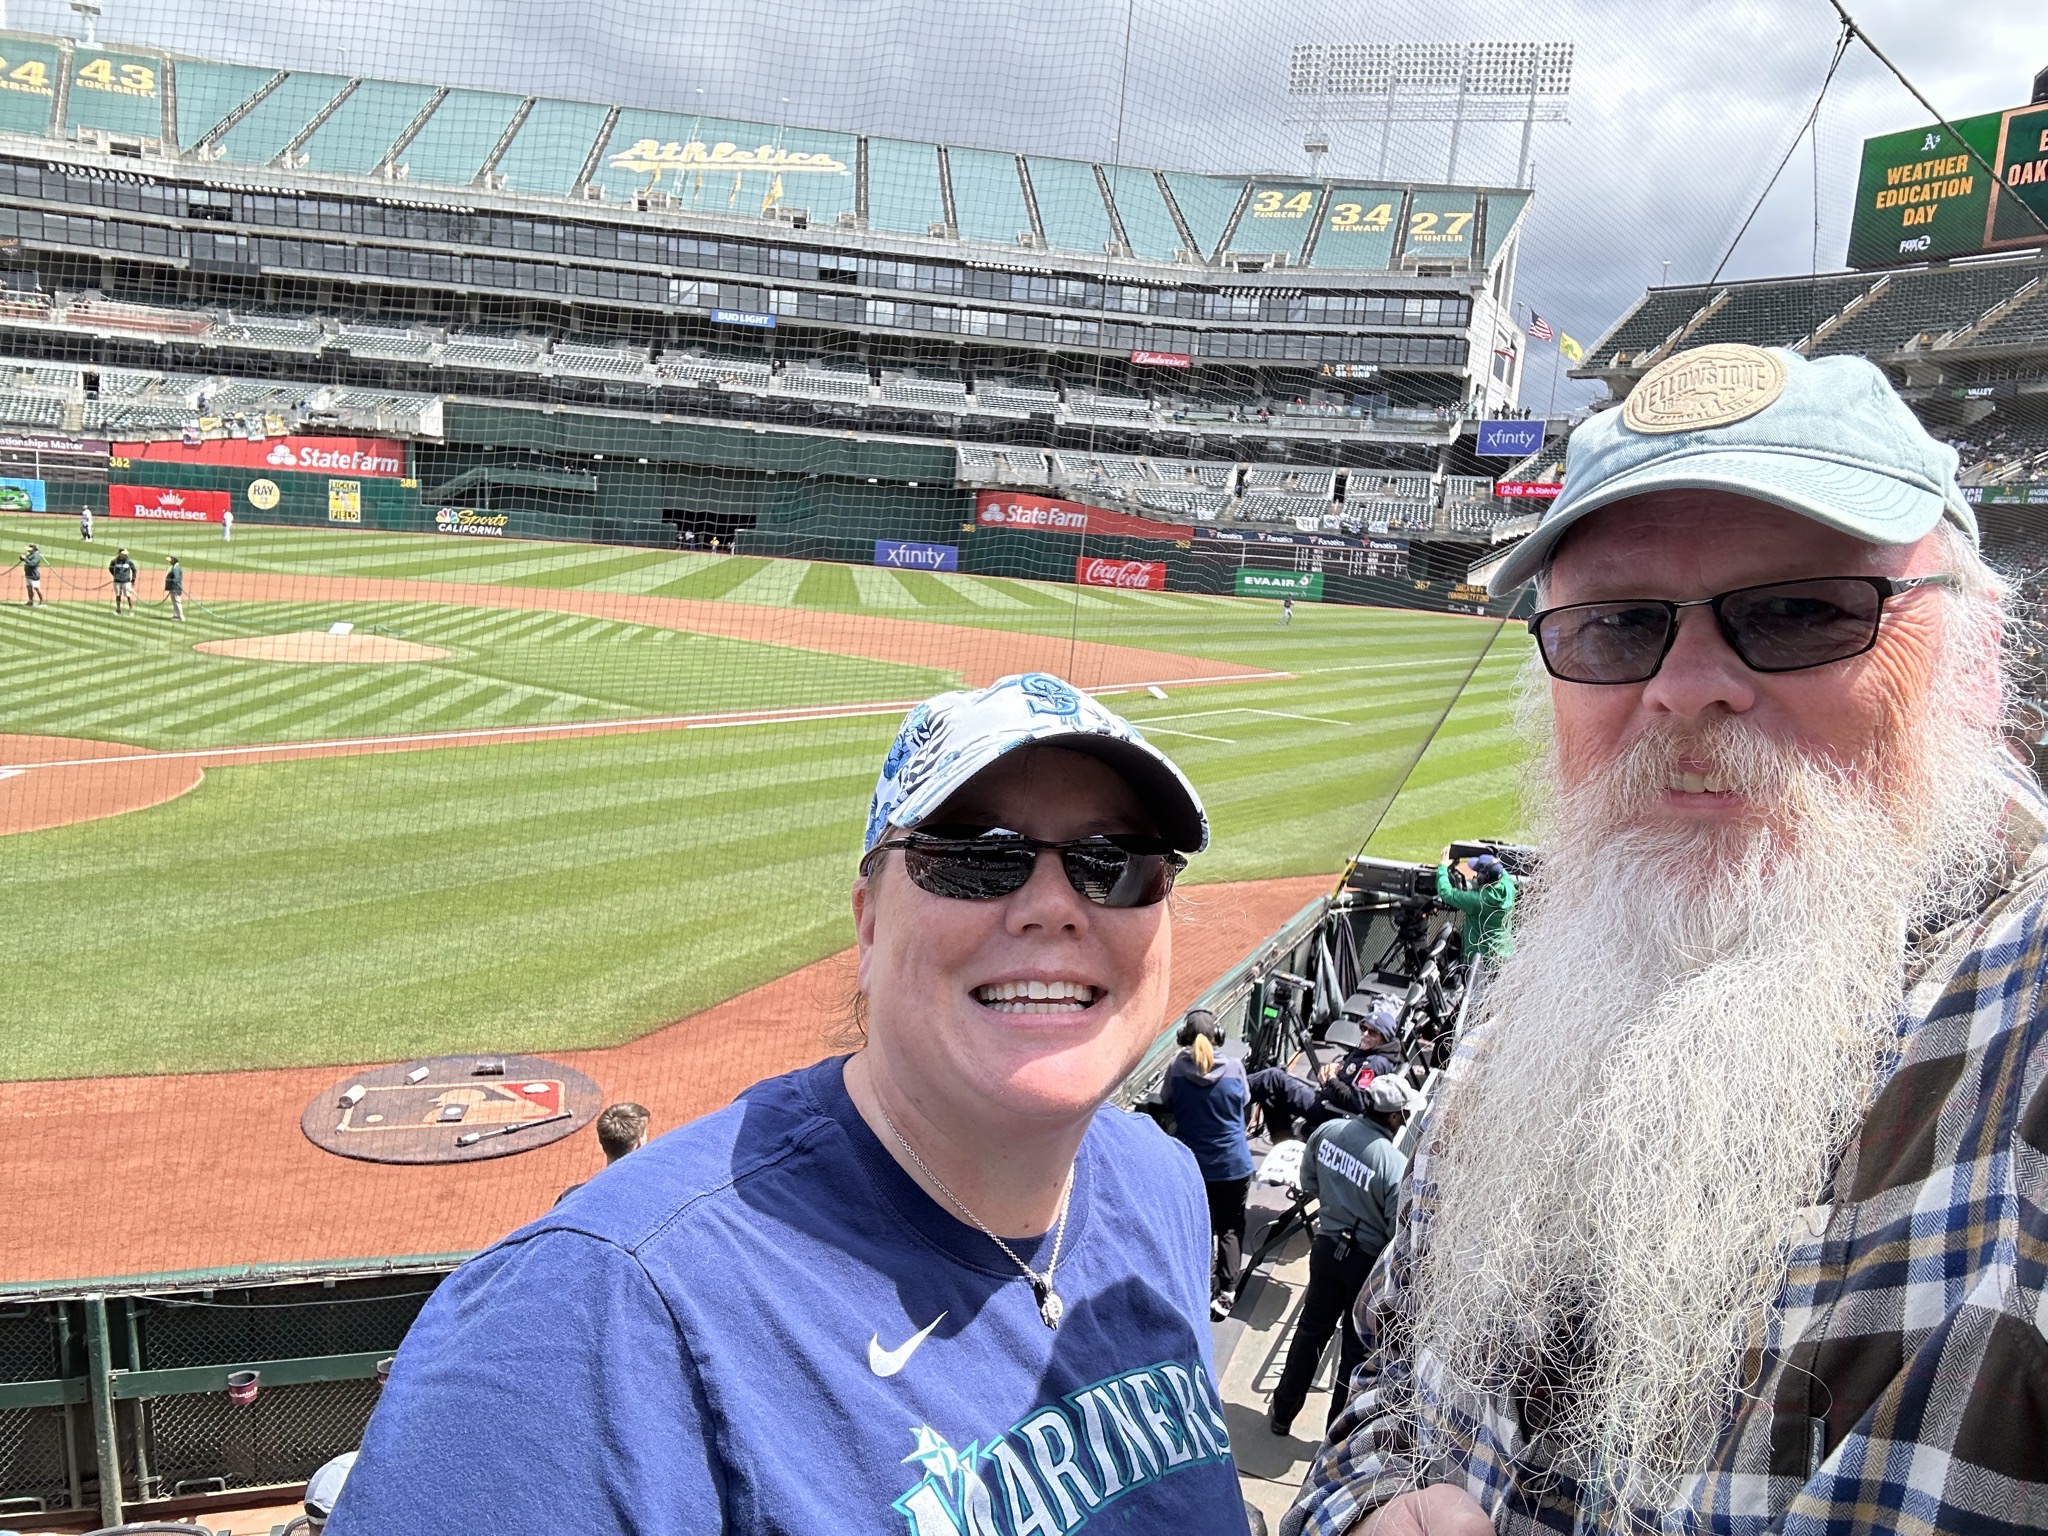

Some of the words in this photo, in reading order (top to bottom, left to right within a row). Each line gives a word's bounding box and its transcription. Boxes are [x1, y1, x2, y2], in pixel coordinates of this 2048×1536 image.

[79, 59, 156, 90] 43
[1921, 133, 1941, 151] A's
[609, 139, 847, 173] Athletics
[1887, 154, 1969, 186] WEATHER
[1876, 175, 1974, 209] EDUCATION
[1253, 191, 1312, 212] 34
[1331, 203, 1393, 226] 34
[1410, 212, 1473, 235] 27
[1903, 204, 1938, 226] DAY
[1331, 224, 1387, 232] STEWART
[1414, 234, 1463, 242] HUNTER
[1900, 238, 1918, 253] FOX
[717, 311, 740, 321] BUD
[740, 314, 769, 324] LIGHT
[1133, 351, 1188, 366] Budweiser
[1638, 364, 1766, 414] YELLOWSTONE
[50, 440, 84, 451] Matter
[1487, 429, 1535, 448] xfinity
[299, 447, 399, 474] StateFarm
[253, 485, 274, 496] RAY
[1500, 485, 1523, 495] 12:16
[134, 505, 207, 521] Budweiser
[332, 511, 358, 520] FIELD
[458, 509, 509, 527] Sports
[1006, 505, 1088, 528] StateFarm
[438, 523, 502, 536] CALIFORNIA
[1216, 531, 1243, 540] Fanatics
[1267, 534, 1294, 543] Fanatics
[1318, 537, 1345, 547] Fanatics
[1369, 540, 1397, 550] Fanatics
[887, 545, 945, 568] xfinity
[1244, 576, 1271, 586] EVA
[1271, 579, 1295, 587] AIR
[1317, 1139, 1376, 1192] SECURITY
[891, 1359, 1232, 1536] MARINERS
